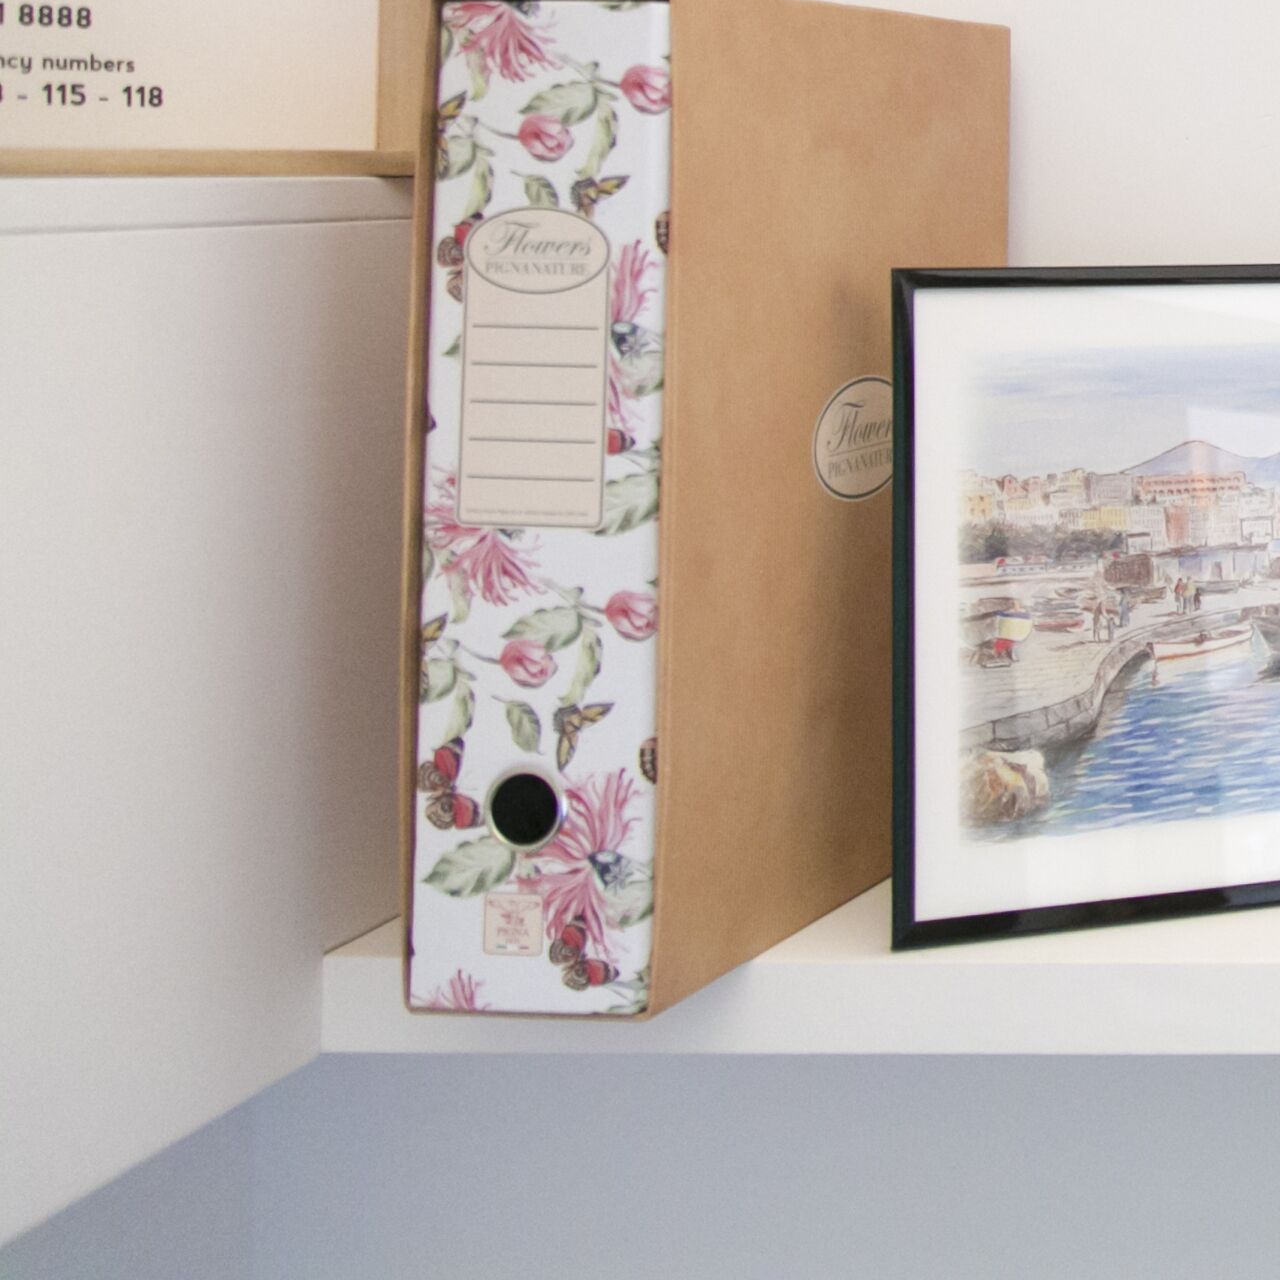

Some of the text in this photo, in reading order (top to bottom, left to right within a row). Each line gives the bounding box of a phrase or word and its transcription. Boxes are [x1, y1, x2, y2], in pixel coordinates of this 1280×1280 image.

[18, 3, 92, 29] 8888
[42, 53, 136, 73] numbers
[42, 82, 87, 107] 115
[122, 85, 163, 108] 118
[483, 220, 592, 257] Flowers
[827, 401, 893, 452] Flower
